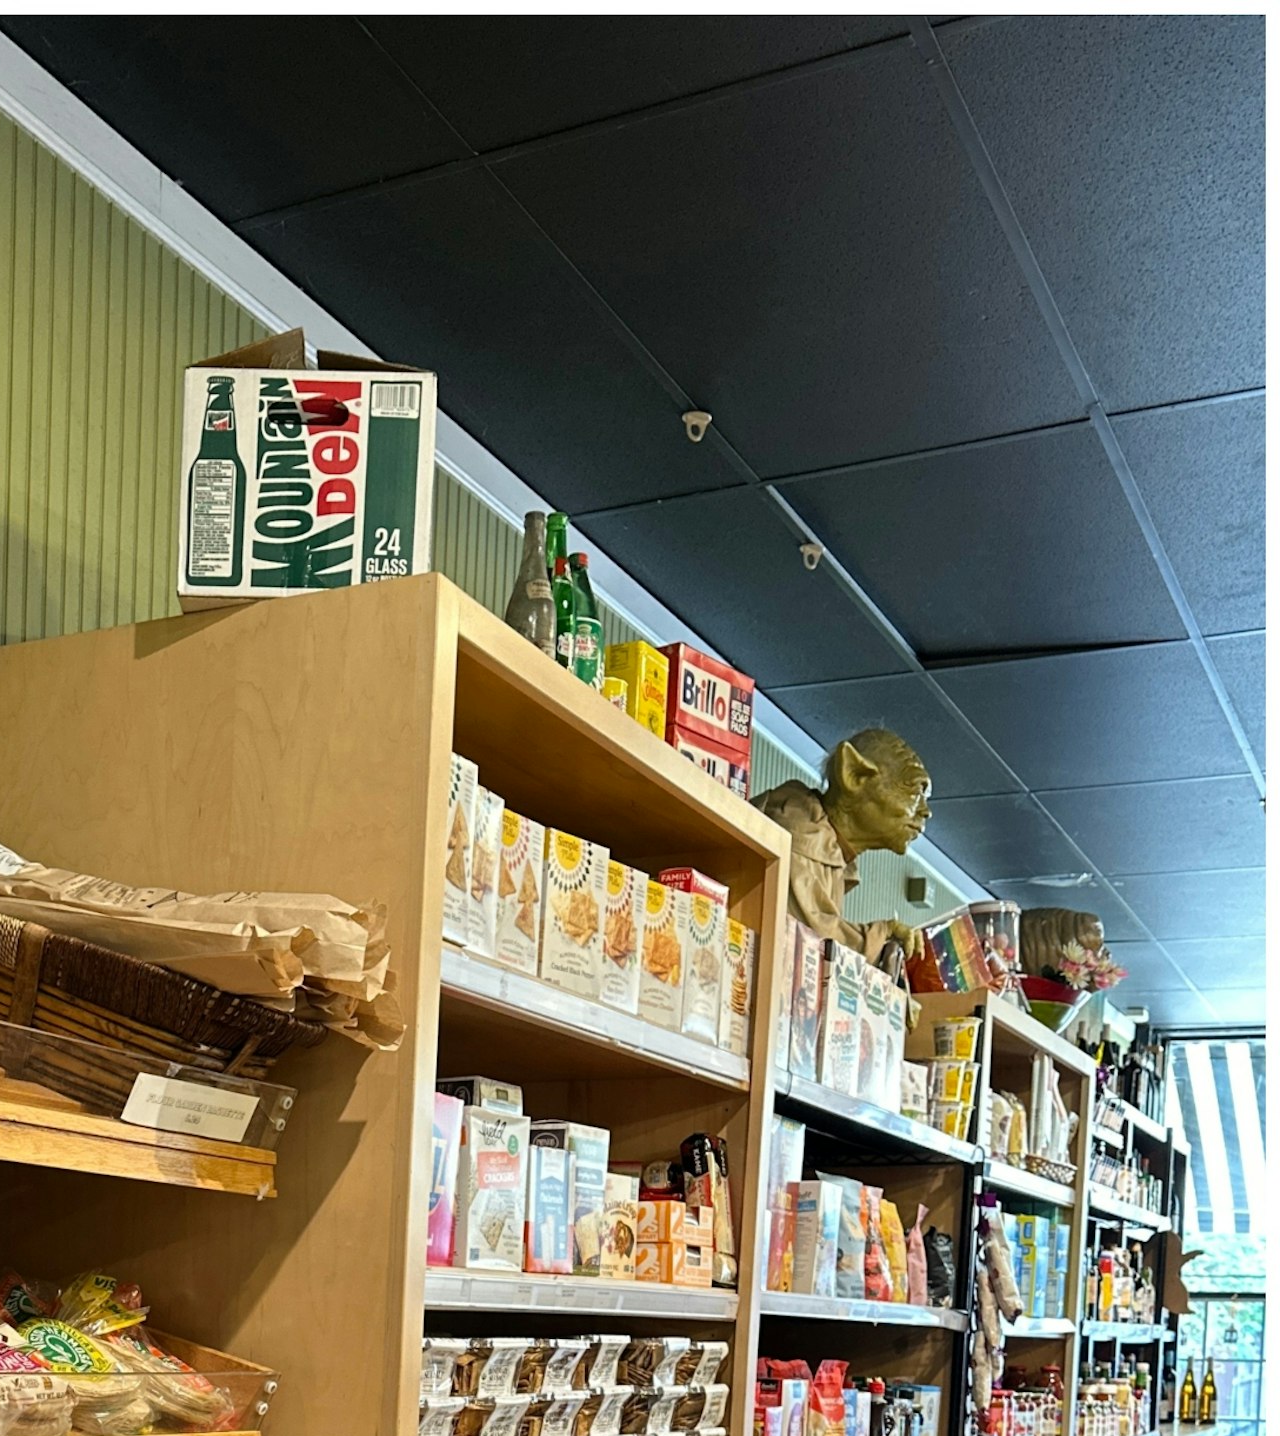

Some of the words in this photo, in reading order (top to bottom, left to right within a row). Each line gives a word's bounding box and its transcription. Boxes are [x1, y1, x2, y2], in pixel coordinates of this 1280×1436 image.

[373, 527, 402, 557] 24
[365, 557, 408, 576] GLASS
[683, 667, 727, 722] Brillo
[730, 710, 751, 727] SOAP
[729, 721, 749, 737] PADS
[660, 872, 692, 884] FAMILY
